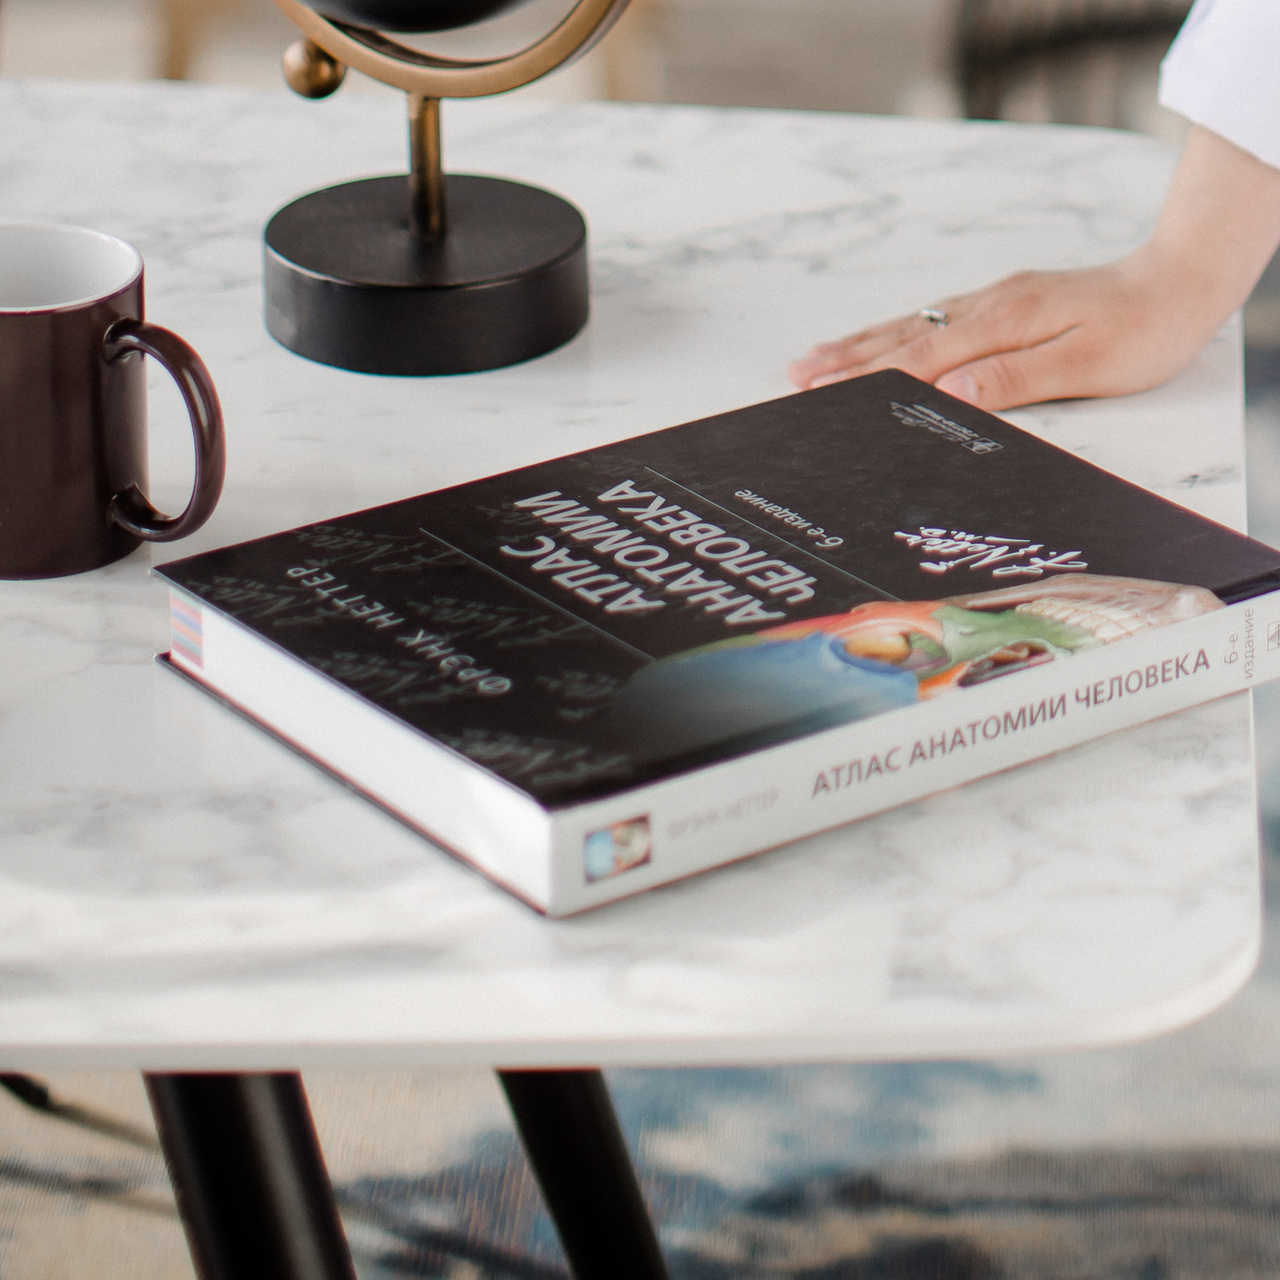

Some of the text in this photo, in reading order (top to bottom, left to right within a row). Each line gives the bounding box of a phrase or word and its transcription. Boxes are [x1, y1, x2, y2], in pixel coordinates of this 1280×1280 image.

[597, 479, 818, 605] ЧЕЛОВЕКА
[734, 489, 844, 548] 6-е издание
[500, 535, 667, 613] АТЛАС
[513, 490, 787, 625] АНАТОМИИ
[286, 566, 405, 630] НЕТТЕР
[397, 628, 512, 695] ФРЭНК
[1244, 607, 1255, 680] издание
[811, 648, 1211, 800] АТЛАС АНАТОМИИ ЧЕЛОВЕКА
